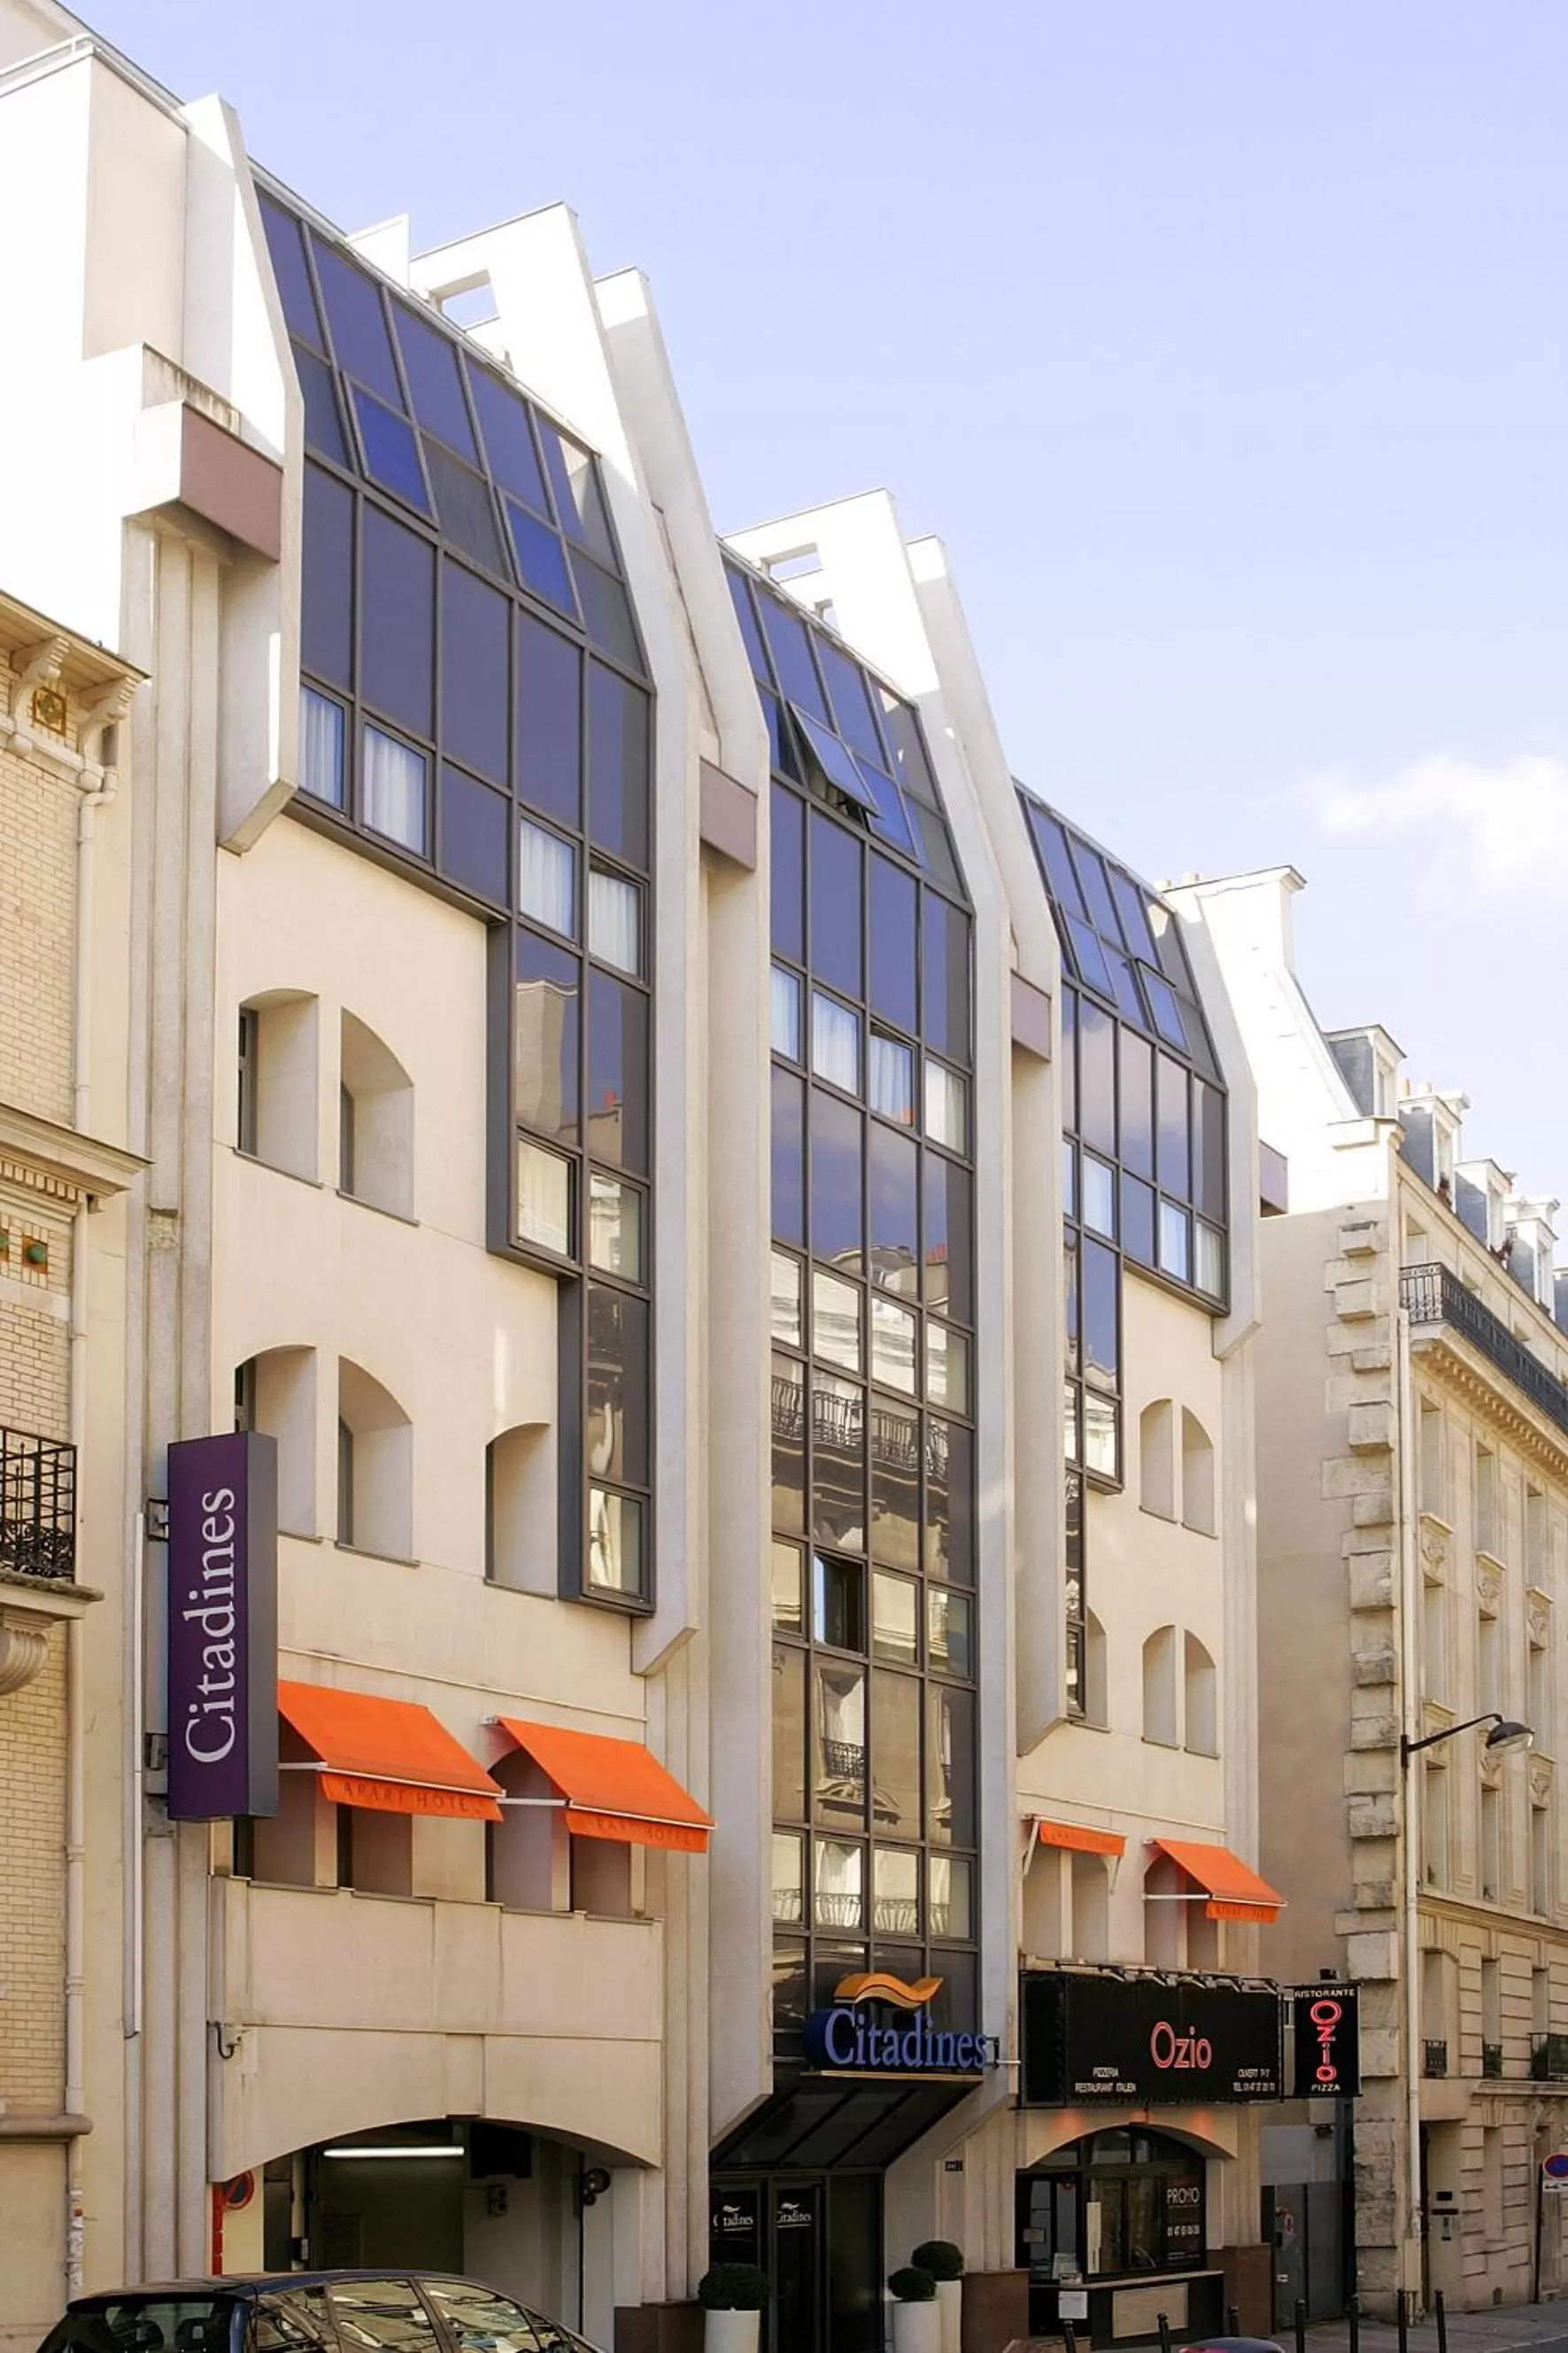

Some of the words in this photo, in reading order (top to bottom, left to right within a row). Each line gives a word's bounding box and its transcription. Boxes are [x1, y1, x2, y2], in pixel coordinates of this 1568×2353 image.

[182, 1487, 236, 1763] Citadines
[1294, 1988, 1356, 1998] RISTORANTE
[824, 2007, 988, 2070] Citadines
[1150, 2021, 1212, 2069] Ozio
